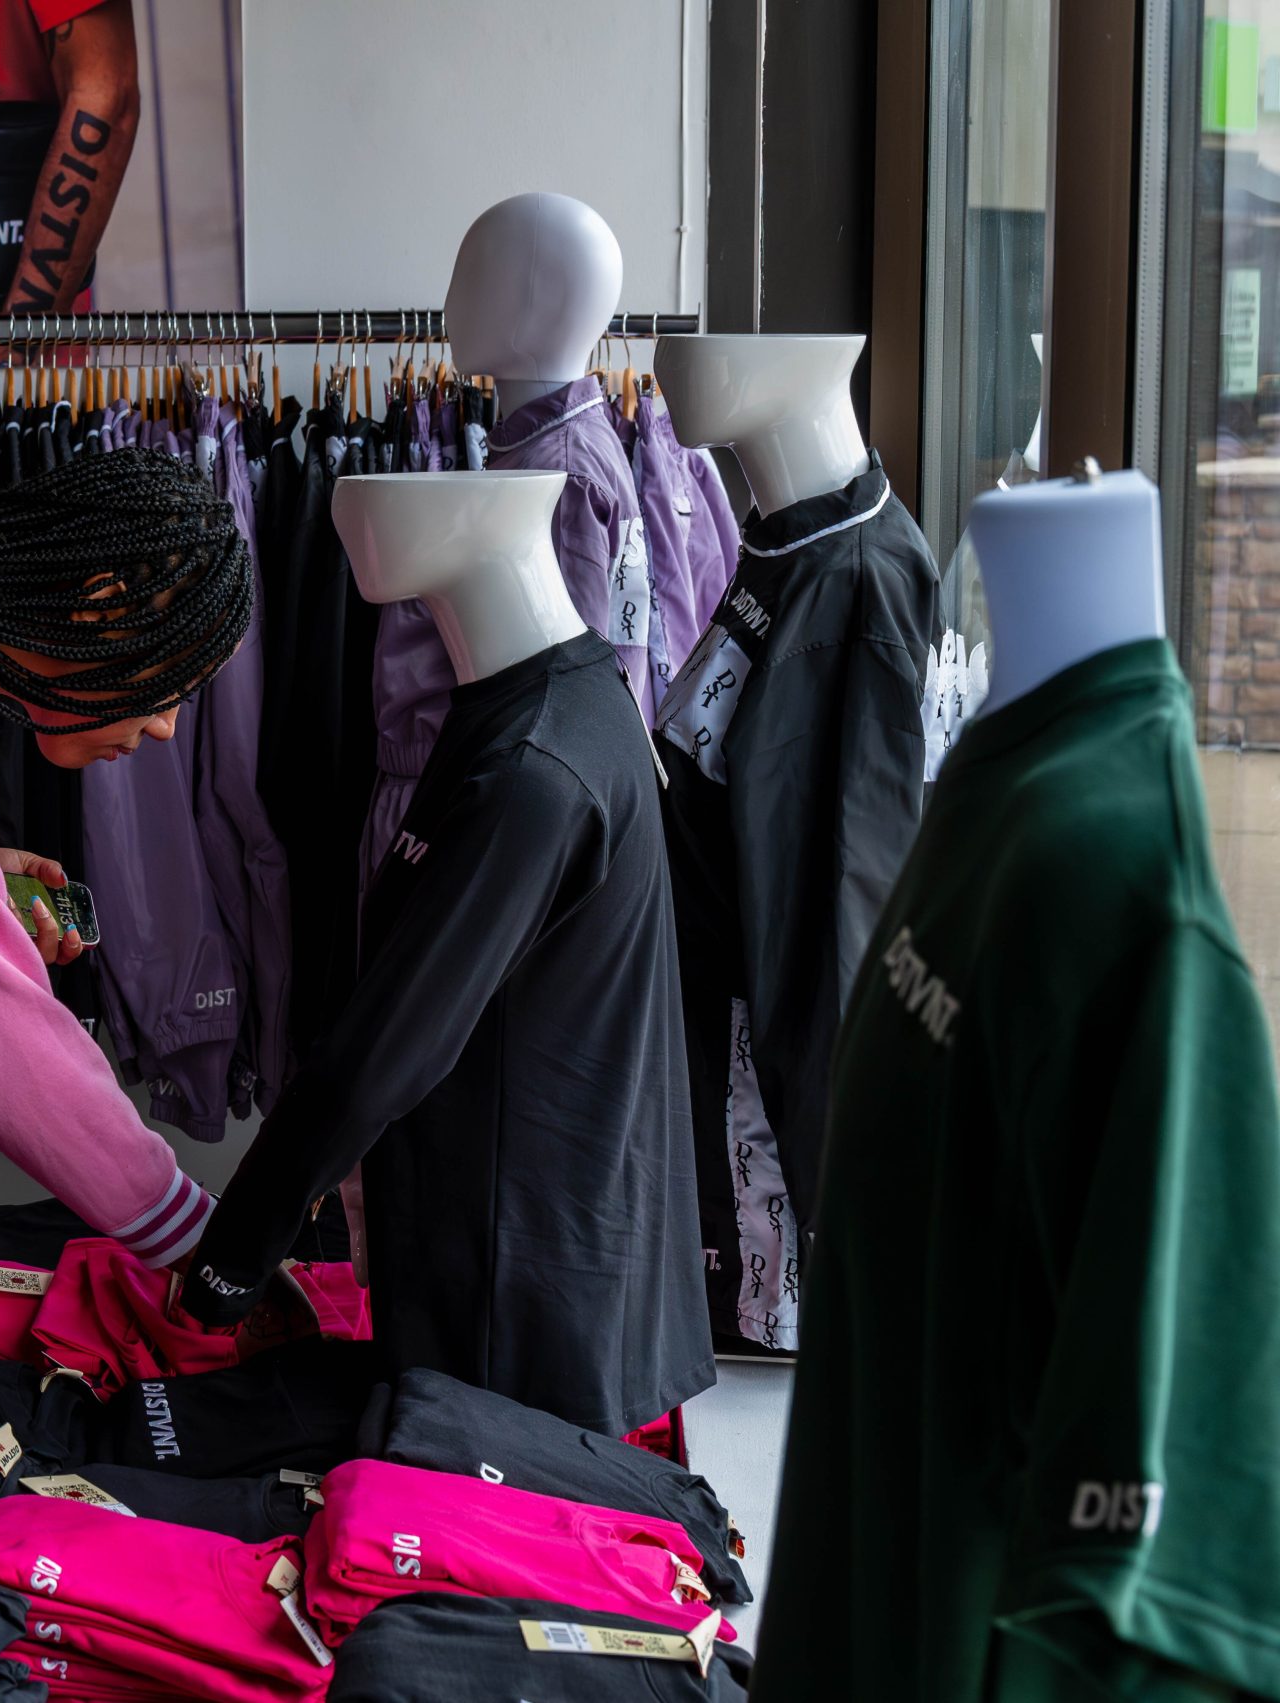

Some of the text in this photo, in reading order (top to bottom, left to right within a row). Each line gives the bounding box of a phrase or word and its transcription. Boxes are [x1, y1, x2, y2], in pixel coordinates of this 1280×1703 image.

[621, 601, 637, 640] DST
[701, 668, 736, 708] DST
[736, 1141, 753, 1187] DST
[766, 1196, 784, 1242] DST
[750, 1253, 766, 1298] DST
[141, 1382, 181, 1461] DISTVNT.
[0, 1444, 20, 1467] DISTVNT
[1070, 1482, 1164, 1538] DIST
[31, 1555, 62, 1595] DIS
[392, 1532, 421, 1579] DIS
